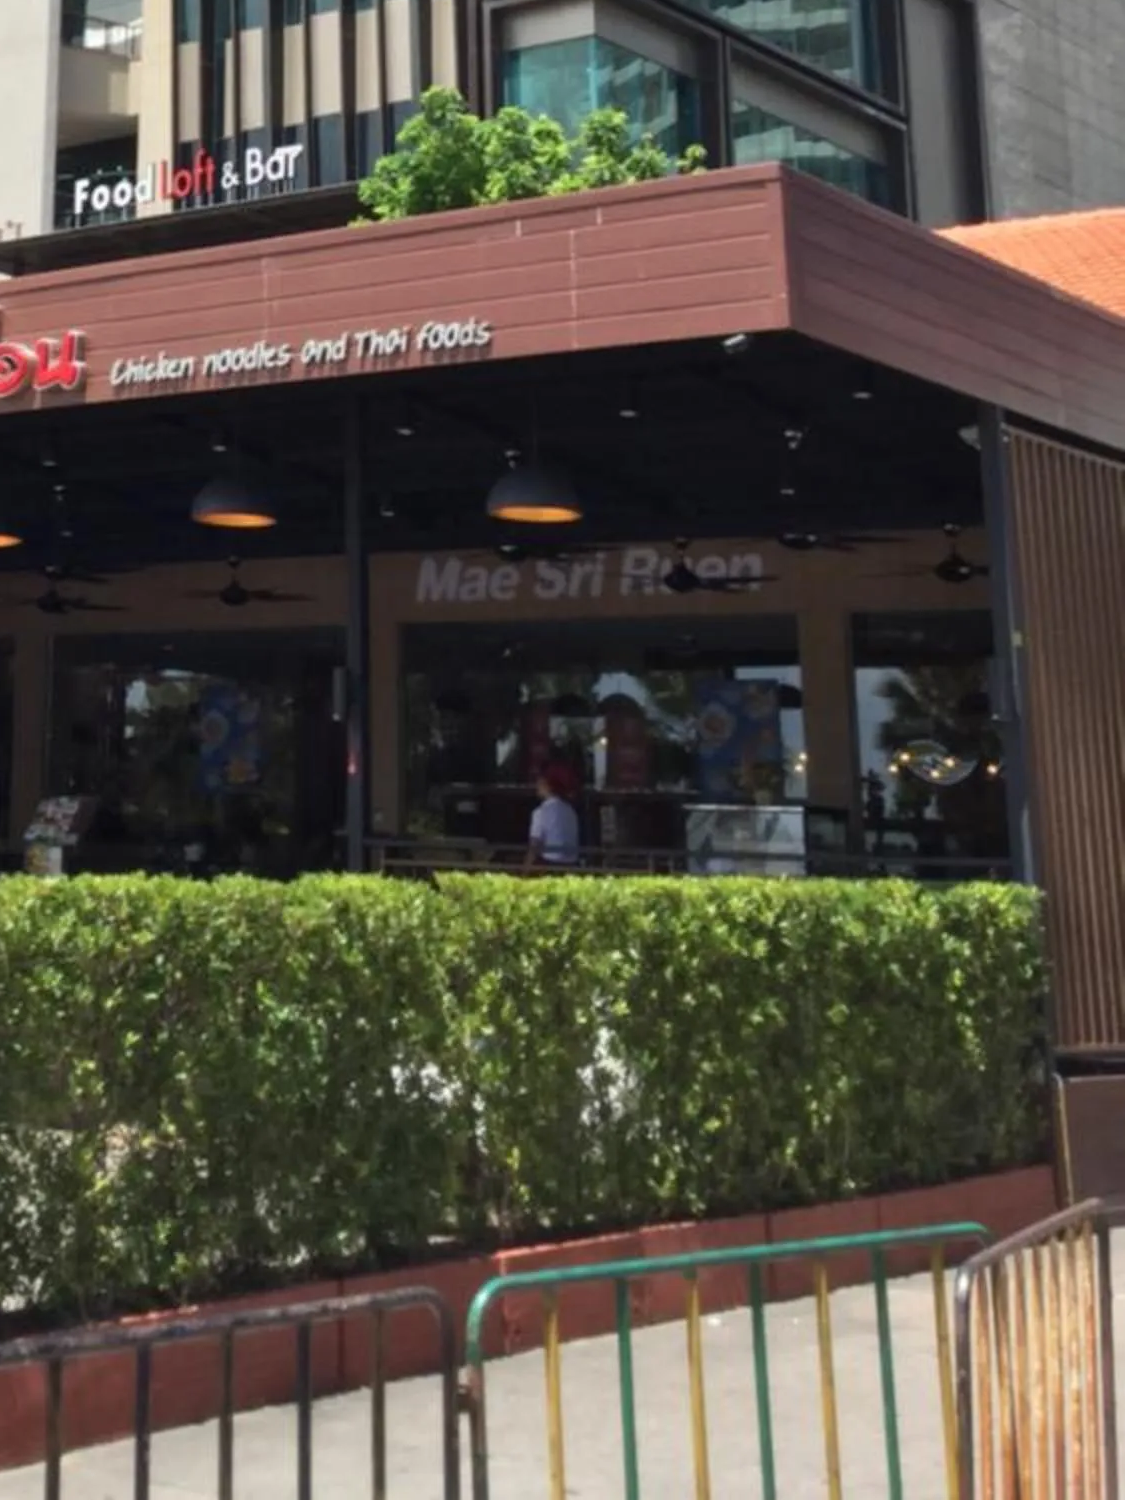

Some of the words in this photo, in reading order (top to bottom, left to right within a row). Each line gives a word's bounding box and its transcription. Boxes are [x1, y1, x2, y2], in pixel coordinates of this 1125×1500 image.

[74, 162, 156, 216] Food
[221, 160, 241, 190] &
[244, 143, 304, 186] Bar
[110, 350, 196, 386] Chicken
[202, 340, 292, 376] noodles
[300, 331, 348, 364] and
[354, 326, 413, 358] Thai
[416, 316, 493, 351] foods
[415, 556, 520, 603] Mae
[533, 552, 607, 600] Sri
